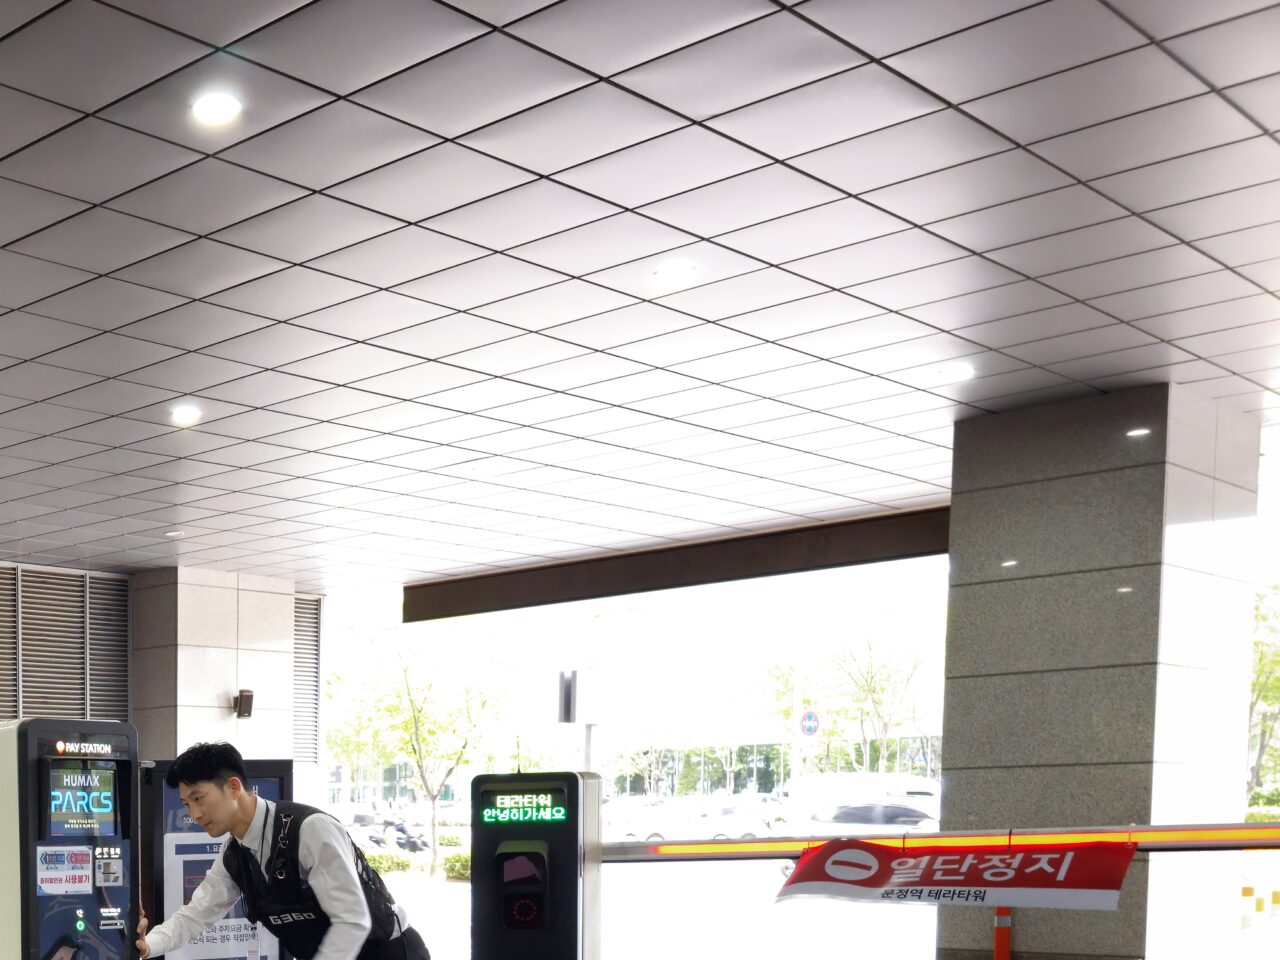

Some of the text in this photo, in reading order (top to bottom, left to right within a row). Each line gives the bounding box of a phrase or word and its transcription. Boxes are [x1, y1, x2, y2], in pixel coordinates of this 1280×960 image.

[65, 743, 111, 753] PAY STATION
[63, 775, 100, 786] HUMAX
[51, 791, 112, 812] PARCS
[496, 794, 552, 808] 테라타워
[483, 807, 566, 821] 안녕히가세요
[889, 851, 1075, 883] 일단정지
[65, 874, 90, 885] 사용불가
[880, 887, 987, 902] 문정역 테라타워
[269, 913, 316, 925] G360
[218, 924, 242, 933] 주차요금
[206, 935, 218, 944] 되는
[220, 934, 231, 943] 경우
